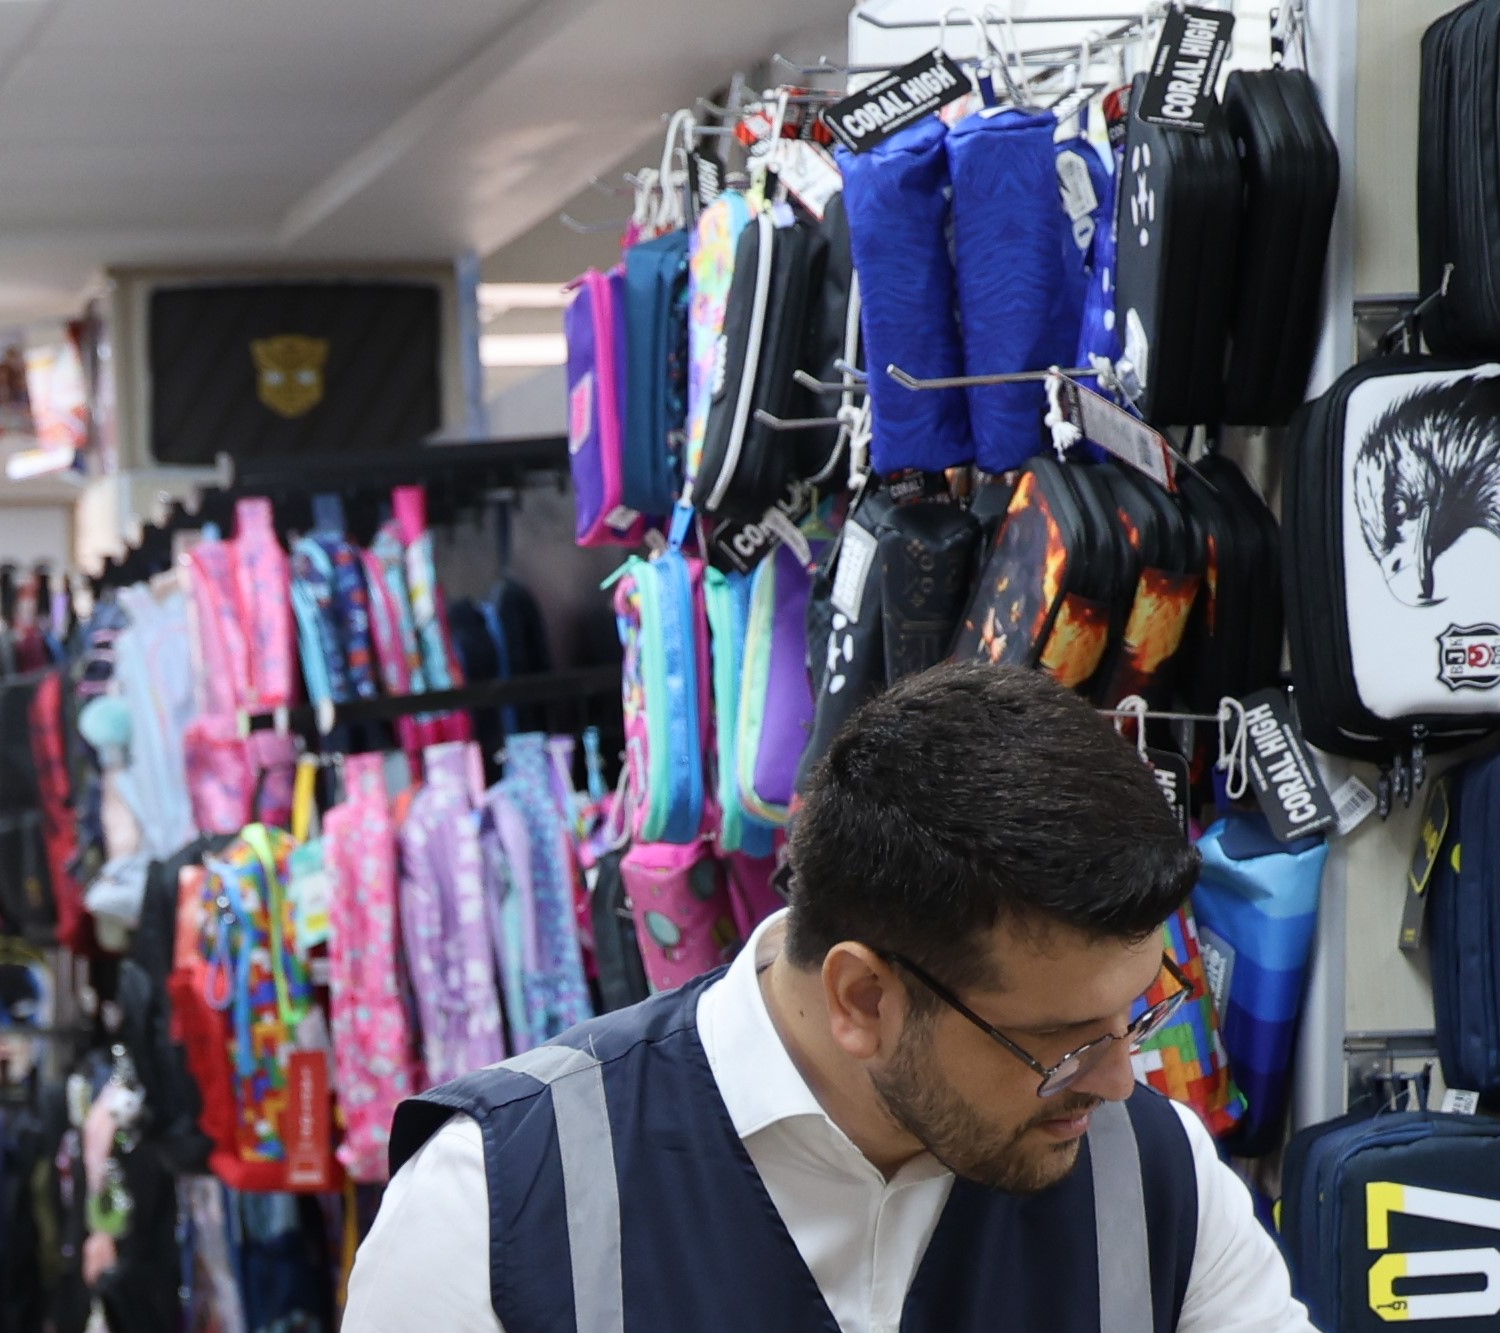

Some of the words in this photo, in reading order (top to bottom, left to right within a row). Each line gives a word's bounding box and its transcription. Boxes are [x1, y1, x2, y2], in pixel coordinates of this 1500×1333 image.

[1182, 17, 1220, 68] HIGH
[842, 90, 912, 140] CORAL
[902, 64, 957, 114] HIGH
[1161, 66, 1205, 119] CORAL
[1246, 703, 1287, 758] HIGH
[1267, 751, 1318, 824] CORAL
